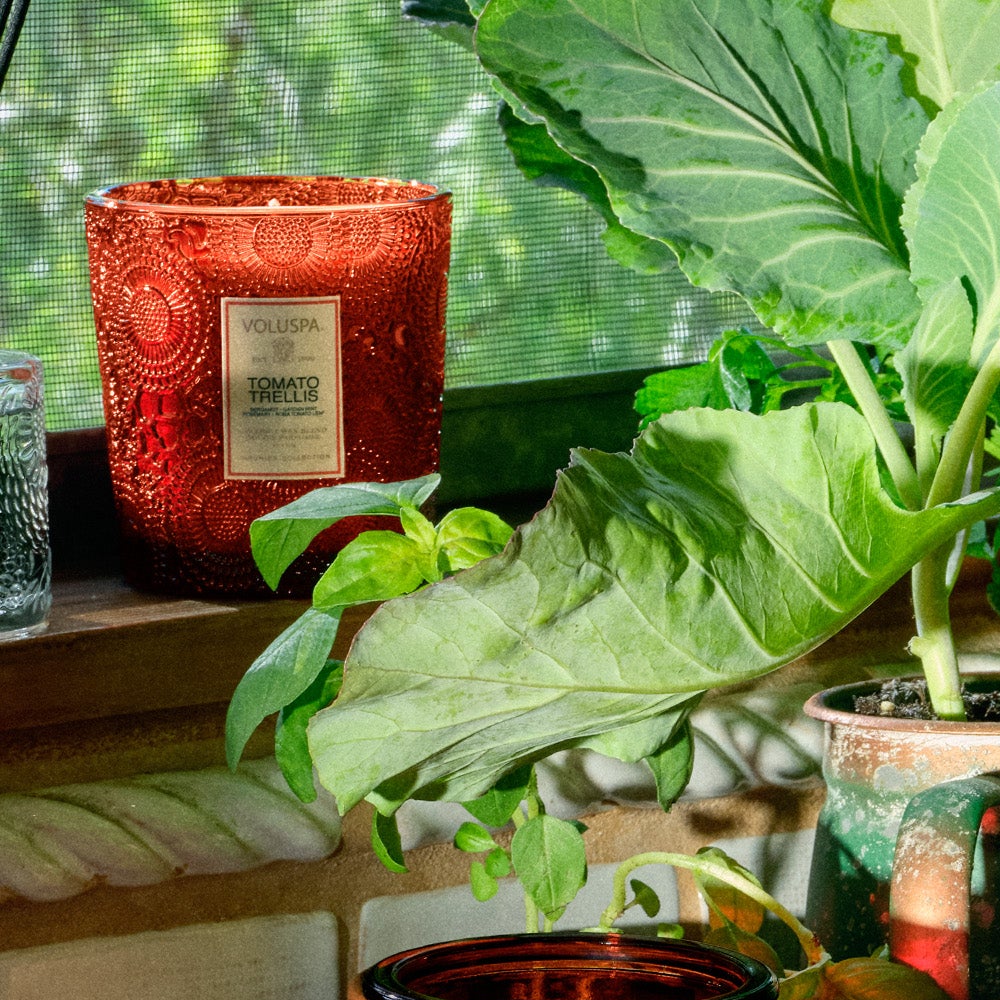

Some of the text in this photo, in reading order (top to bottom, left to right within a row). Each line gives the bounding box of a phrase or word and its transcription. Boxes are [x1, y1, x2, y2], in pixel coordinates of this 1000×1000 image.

[242, 318, 320, 334] VOLUSPA
[247, 376, 319, 390] TOMATO
[248, 390, 319, 403] TRELLIS
